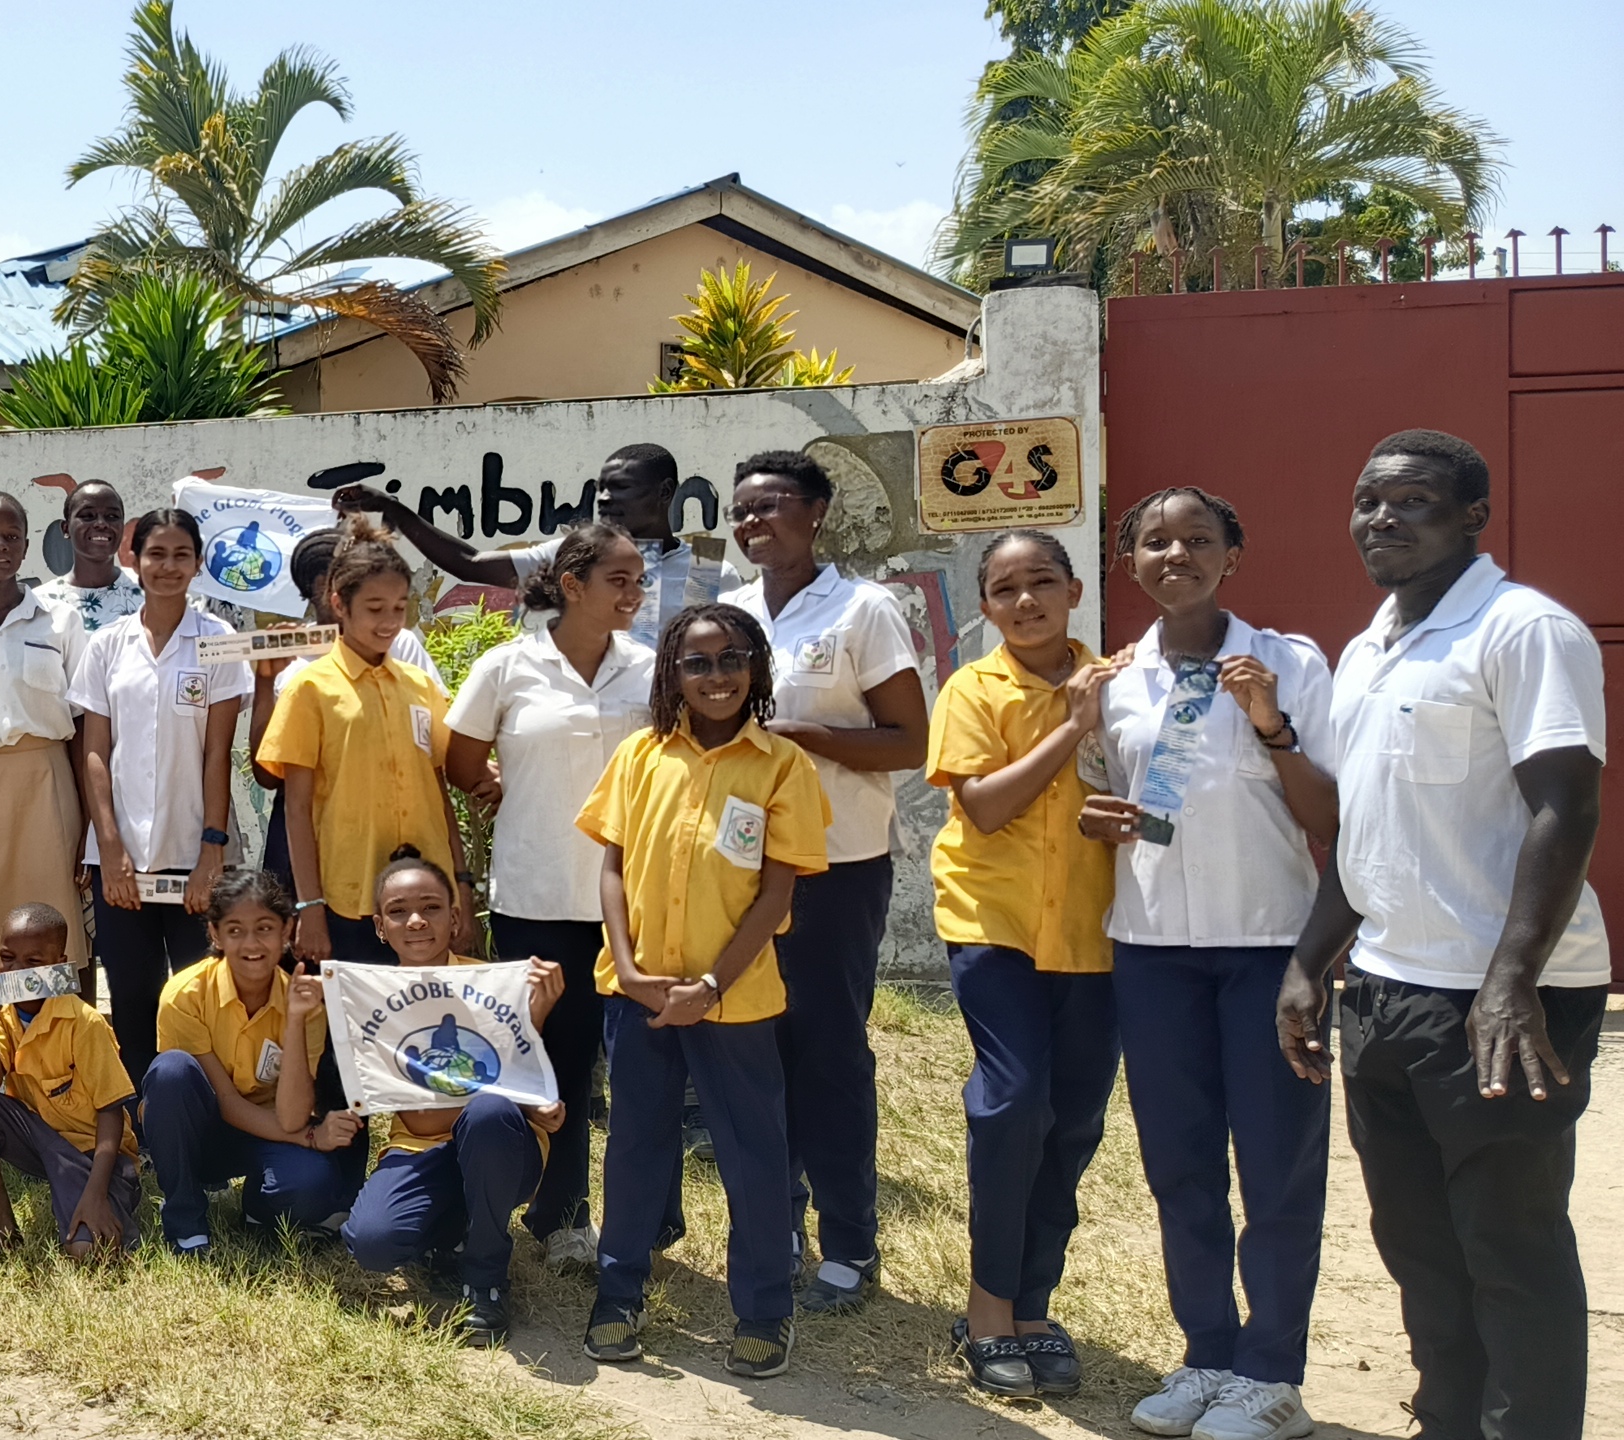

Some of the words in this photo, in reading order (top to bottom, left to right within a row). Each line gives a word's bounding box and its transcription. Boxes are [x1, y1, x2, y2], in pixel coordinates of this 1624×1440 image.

[963, 428, 1016, 438] PROTECTED
[1017, 426, 1030, 435] BY
[941, 440, 1058, 500] G4S
[193, 507, 212, 525] he
[361, 1008, 388, 1045] The
[386, 981, 455, 1013] GLOBE
[462, 983, 532, 1056] Program
